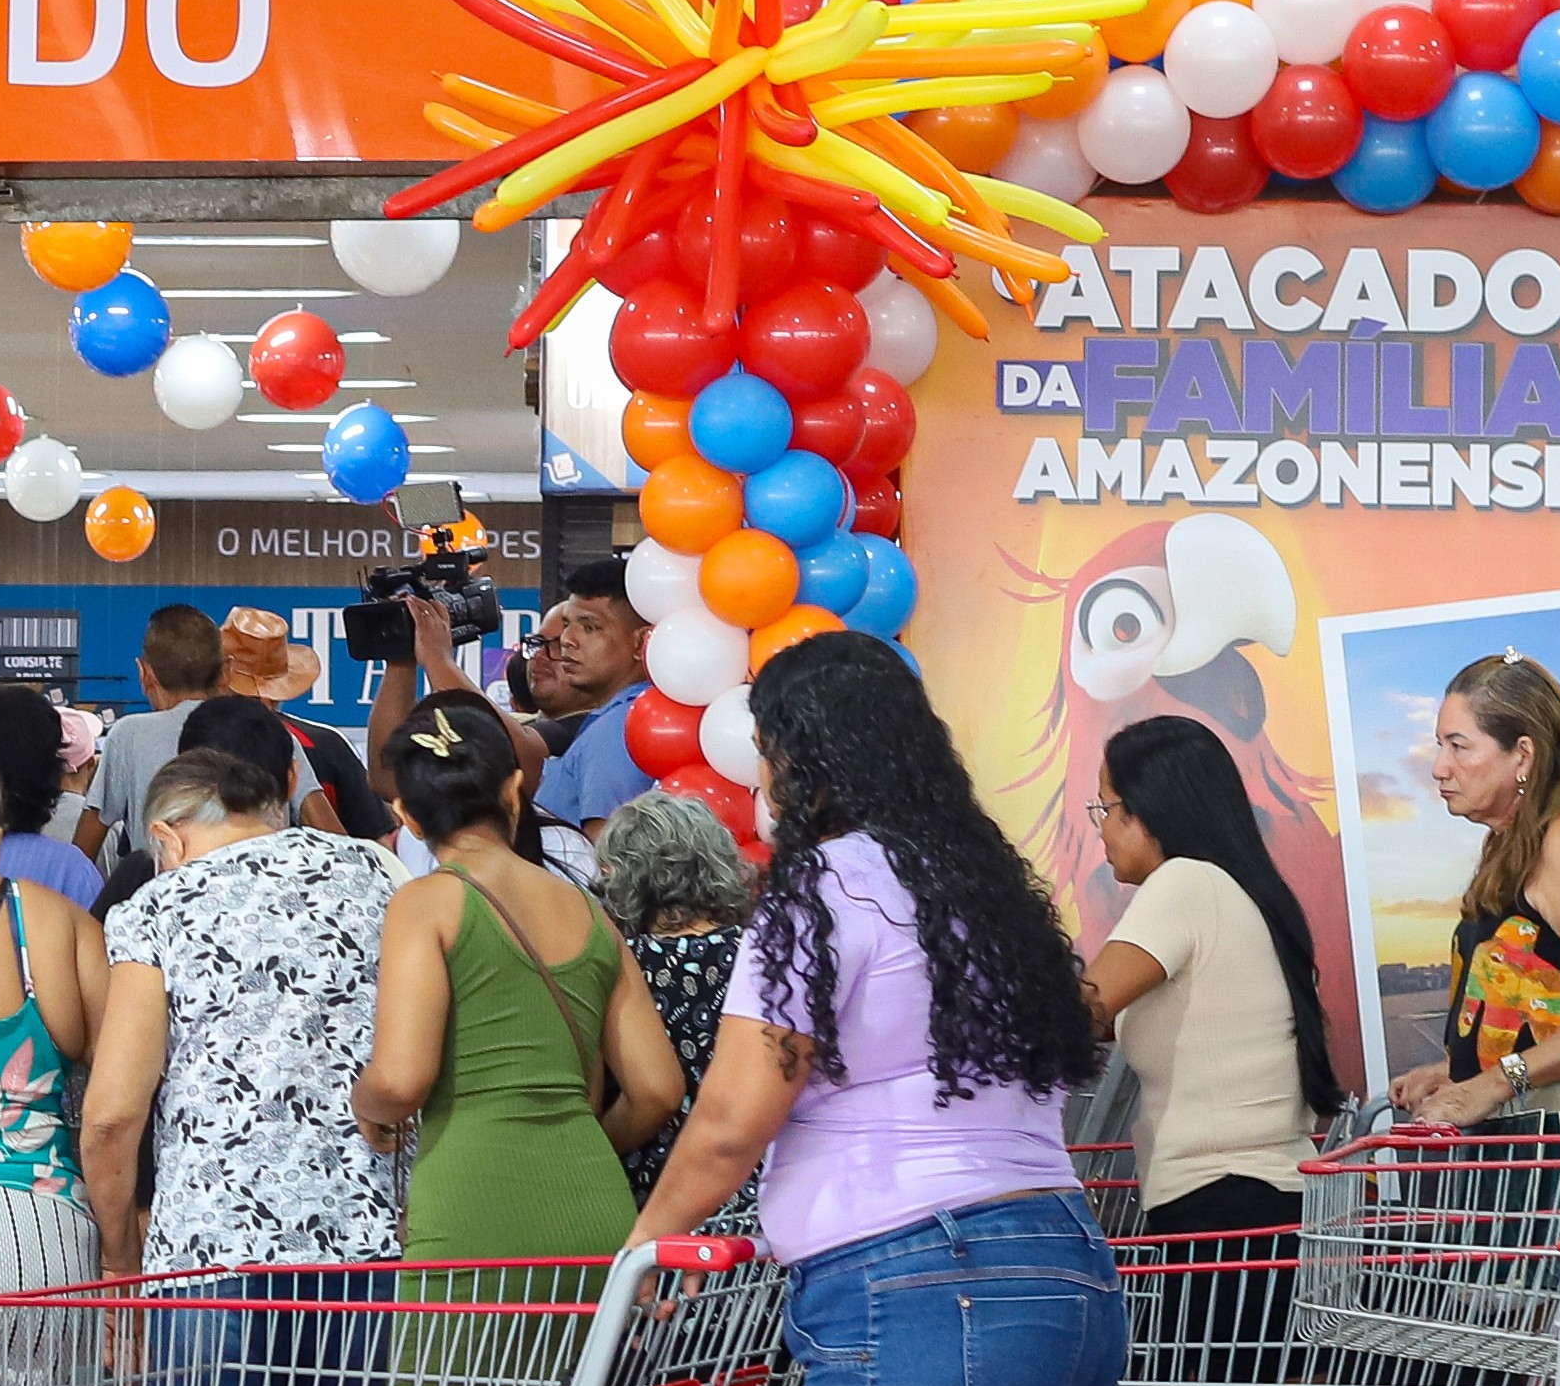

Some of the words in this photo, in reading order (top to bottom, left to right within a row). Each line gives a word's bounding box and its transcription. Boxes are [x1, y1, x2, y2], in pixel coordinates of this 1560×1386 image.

[1002, 364, 1079, 409] DA
[217, 528, 240, 557] O
[250, 528, 393, 558] MELHOR
[4, 656, 63, 669] CONSULTE
